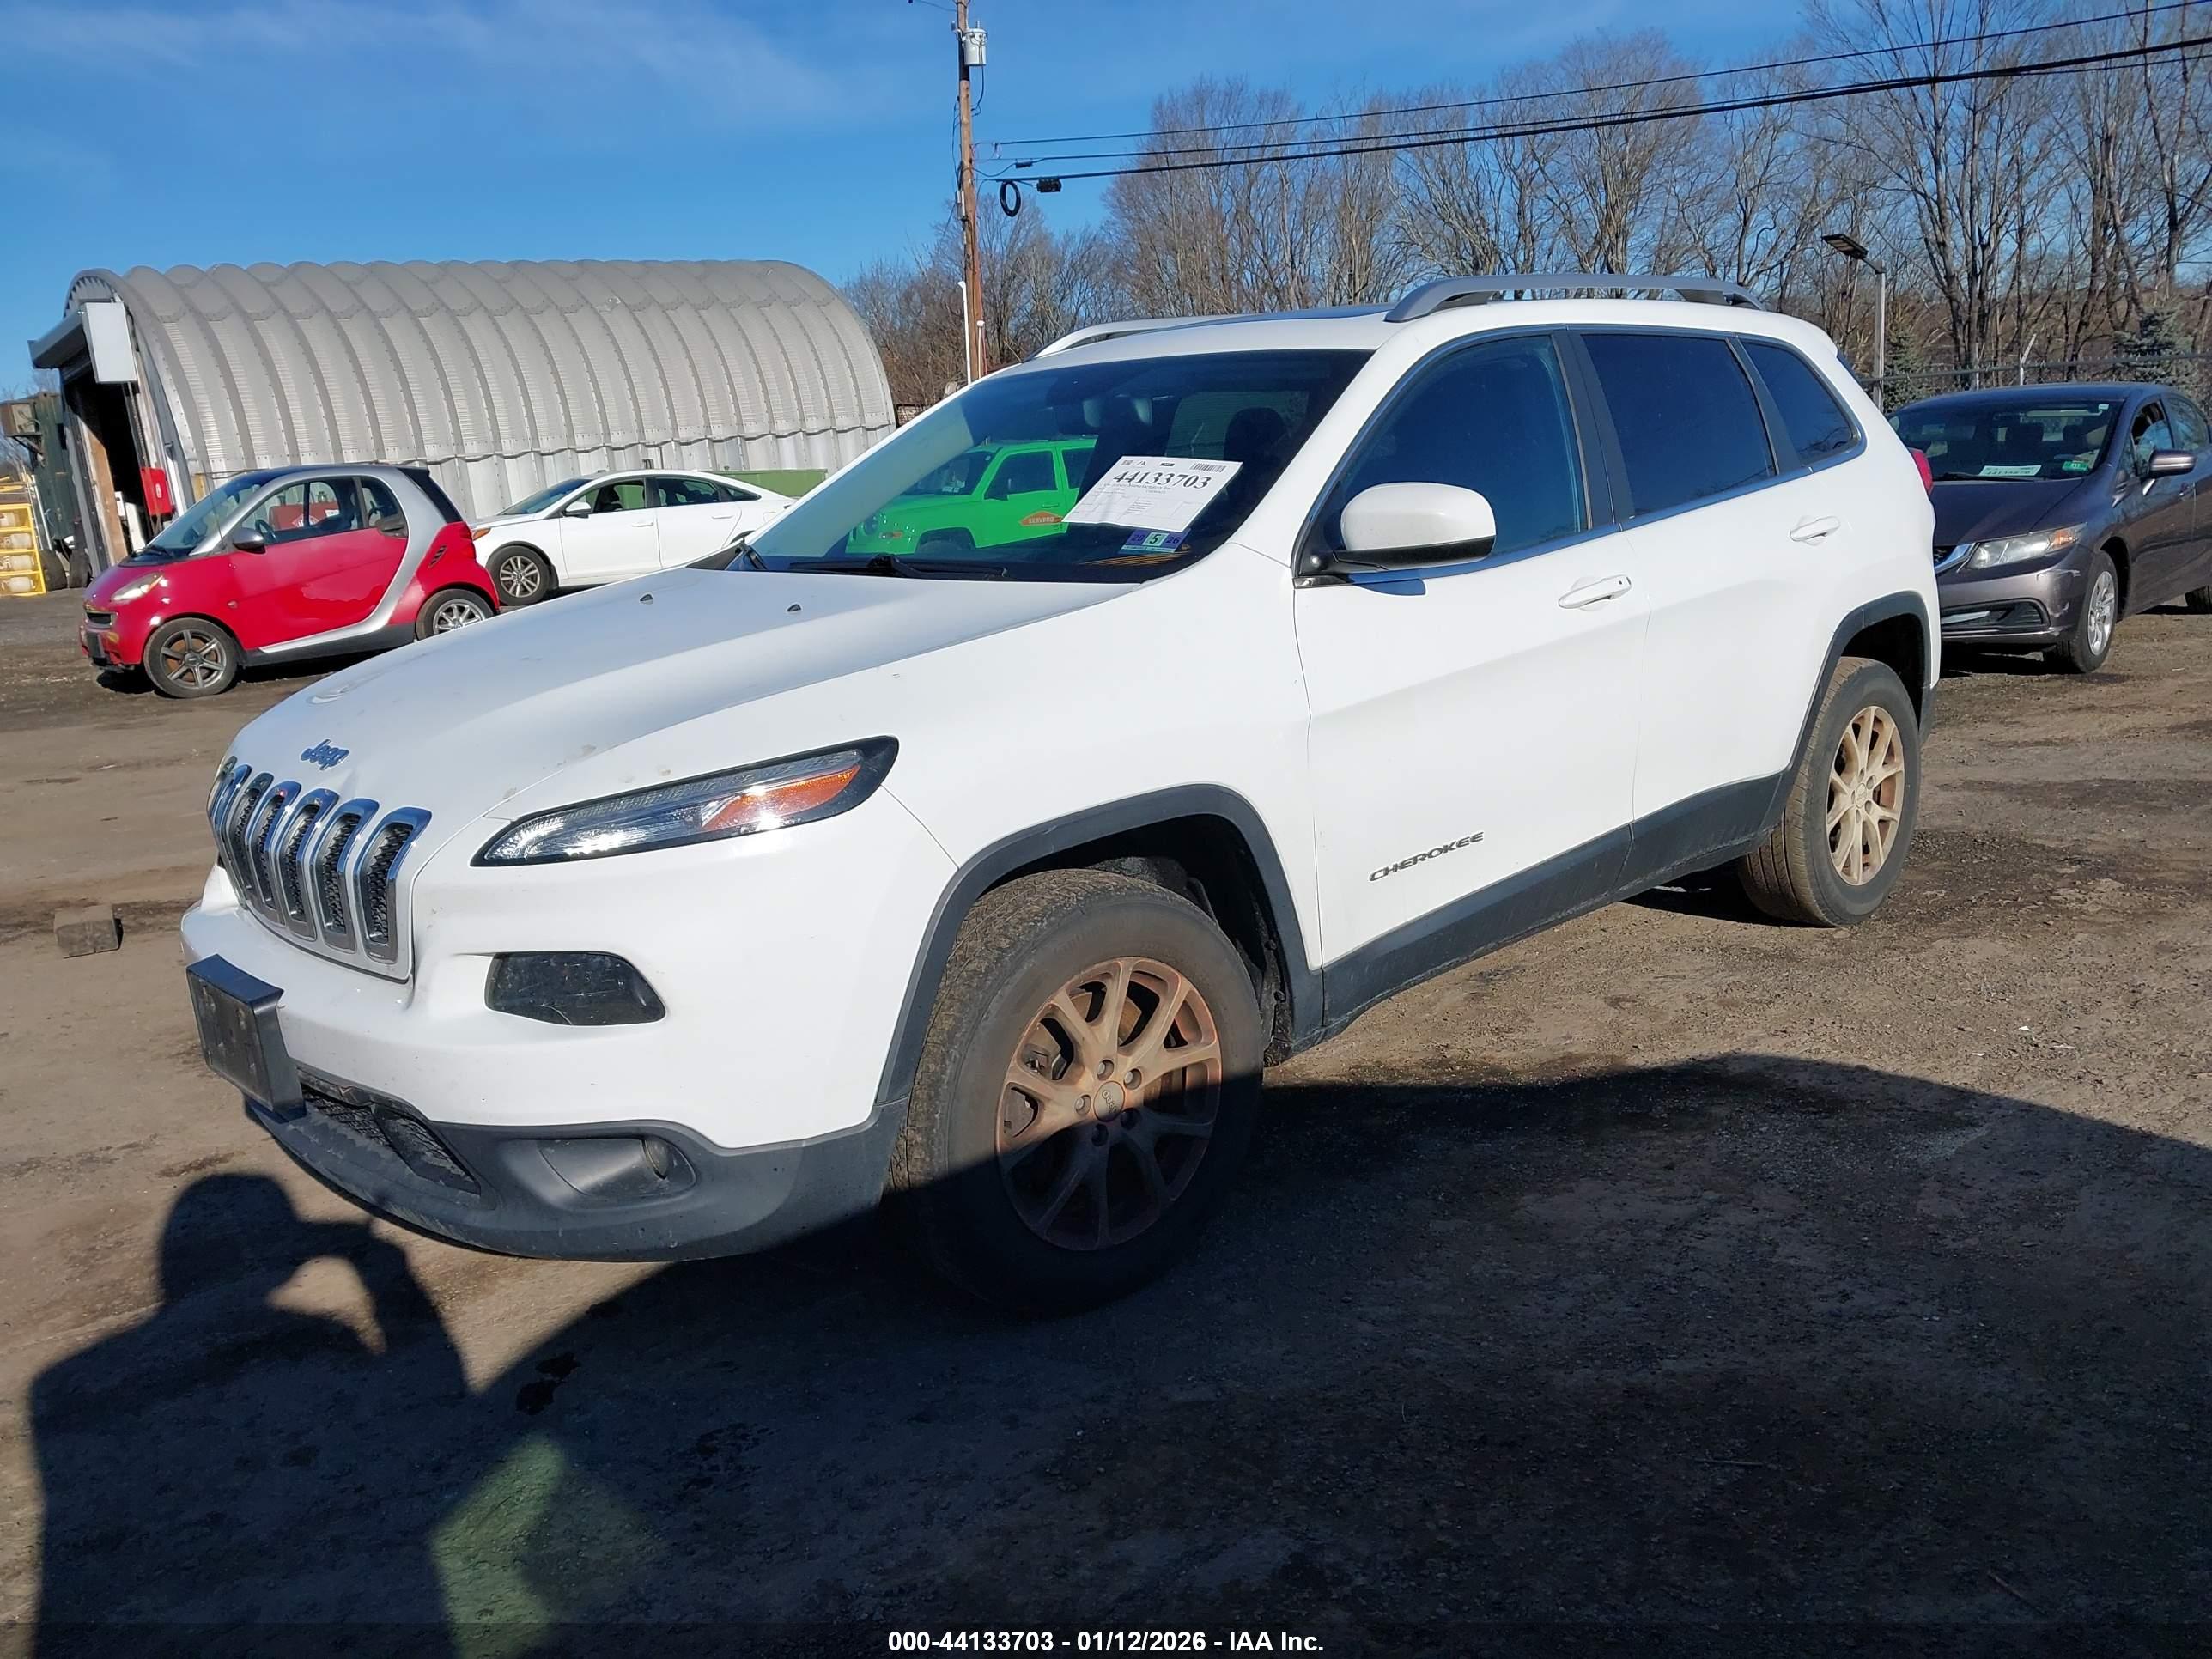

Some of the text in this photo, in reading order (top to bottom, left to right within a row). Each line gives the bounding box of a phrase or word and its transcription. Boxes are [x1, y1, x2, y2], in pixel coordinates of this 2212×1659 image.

[1113, 471, 1212, 489] 44133703
[1149, 534, 1162, 544] 5
[301, 739, 349, 770] Jeep
[1369, 831, 1484, 881] CHEROKEE
